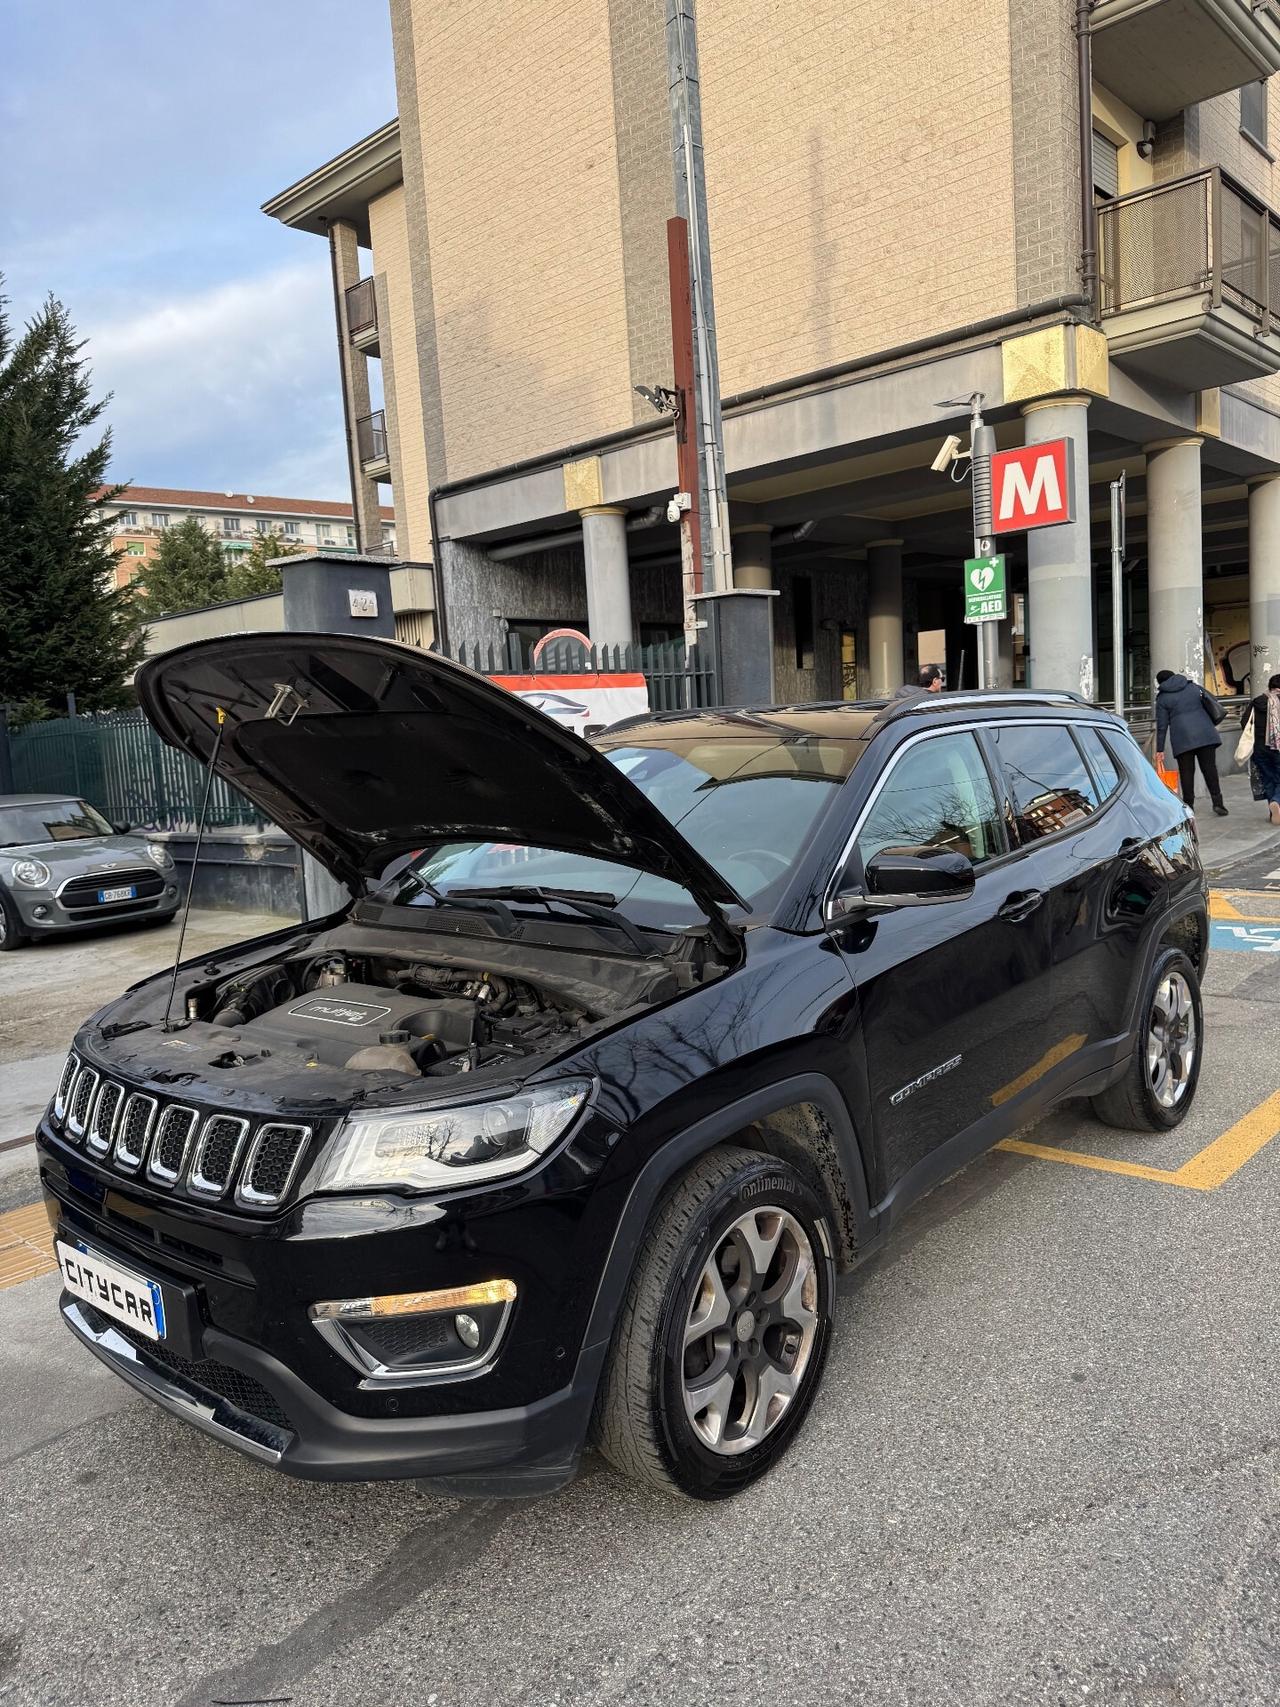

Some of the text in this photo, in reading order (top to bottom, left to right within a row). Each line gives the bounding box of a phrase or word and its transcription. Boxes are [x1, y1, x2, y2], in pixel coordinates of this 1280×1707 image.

[998, 454, 1063, 521] M
[980, 599, 1003, 614] AED
[890, 1053, 962, 1106] COMPASS
[64, 1257, 154, 1327] CITYCAR
